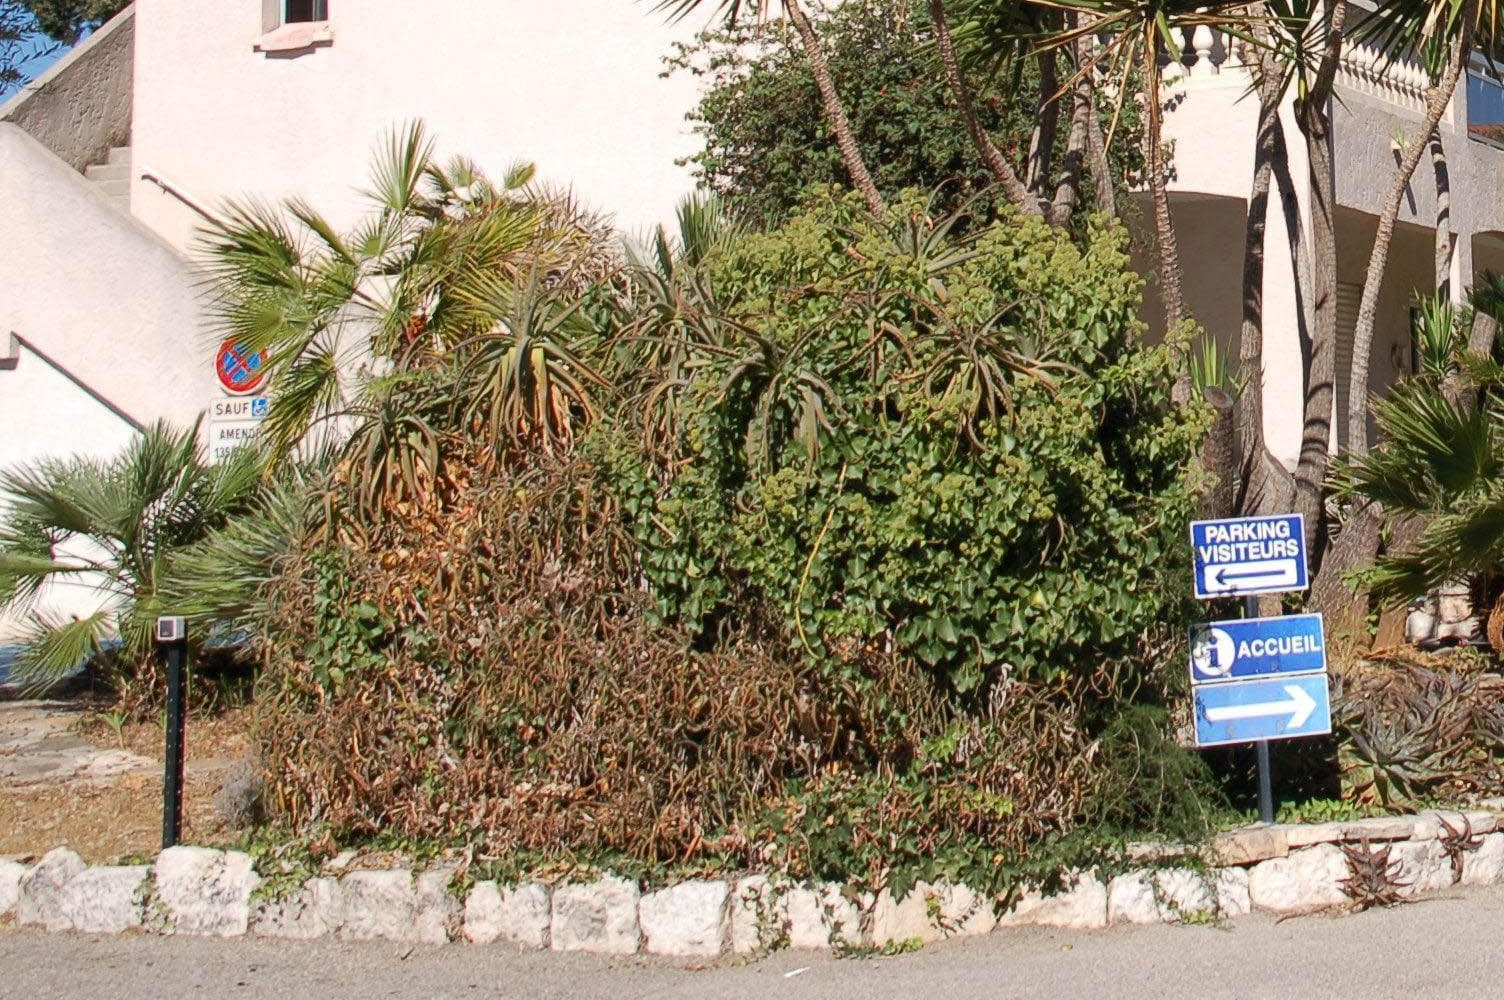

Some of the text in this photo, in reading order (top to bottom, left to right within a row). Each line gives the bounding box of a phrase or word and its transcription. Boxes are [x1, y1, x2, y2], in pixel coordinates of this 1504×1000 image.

[216, 402, 249, 415] SAUF
[1205, 520, 1290, 544] PARKING
[1199, 538, 1299, 563] VISITEURS
[1237, 634, 1321, 659] ACCUEIL
